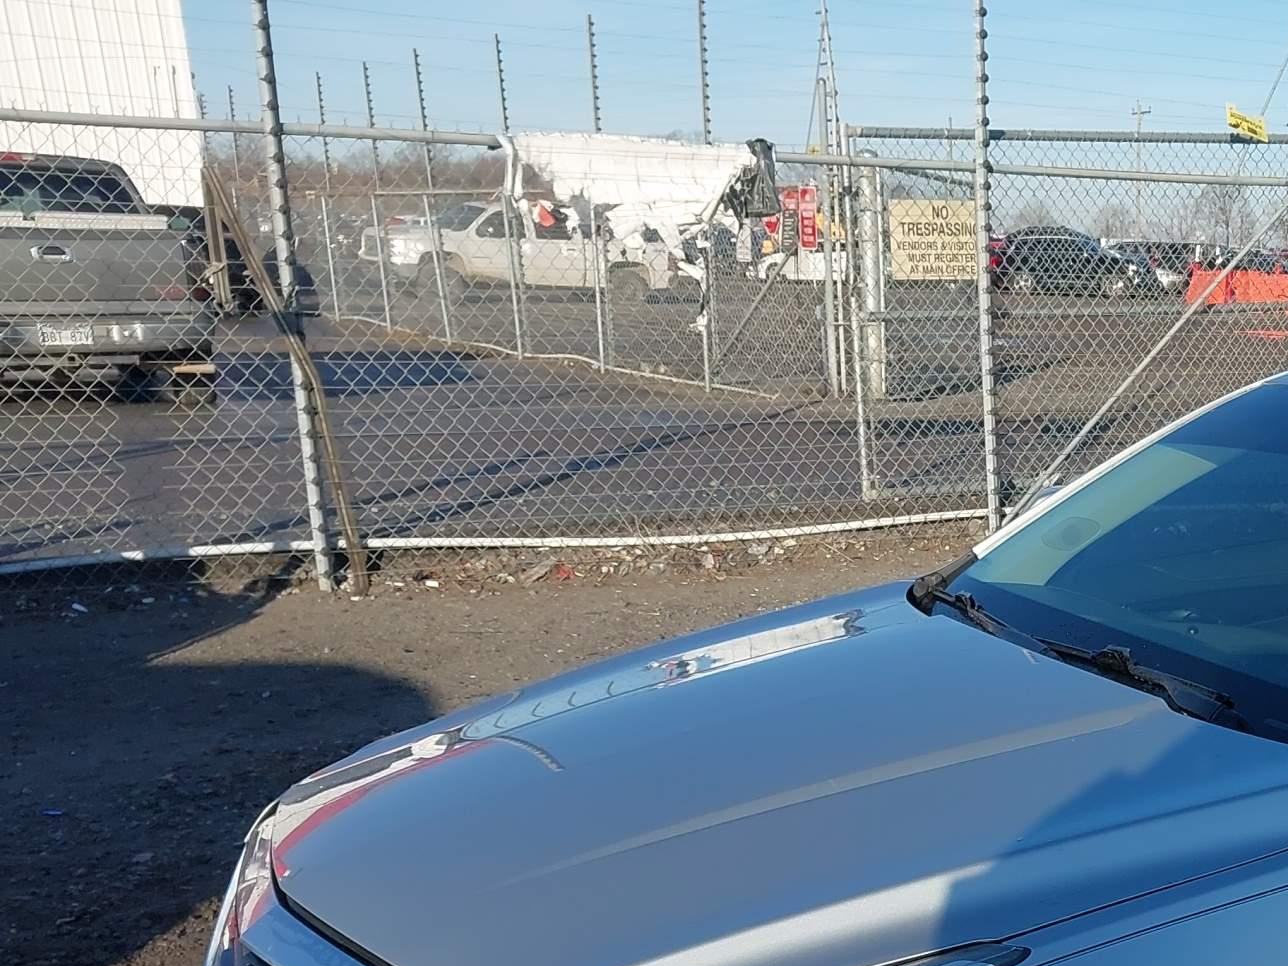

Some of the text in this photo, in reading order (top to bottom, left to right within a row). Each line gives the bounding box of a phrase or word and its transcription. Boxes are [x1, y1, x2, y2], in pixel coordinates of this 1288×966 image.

[931, 205, 949, 220] NO
[897, 241, 975, 251] VENDORS & VISITO
[908, 253, 976, 263] MUST REGISTER
[909, 265, 976, 275] AT MAIN OFFICE
